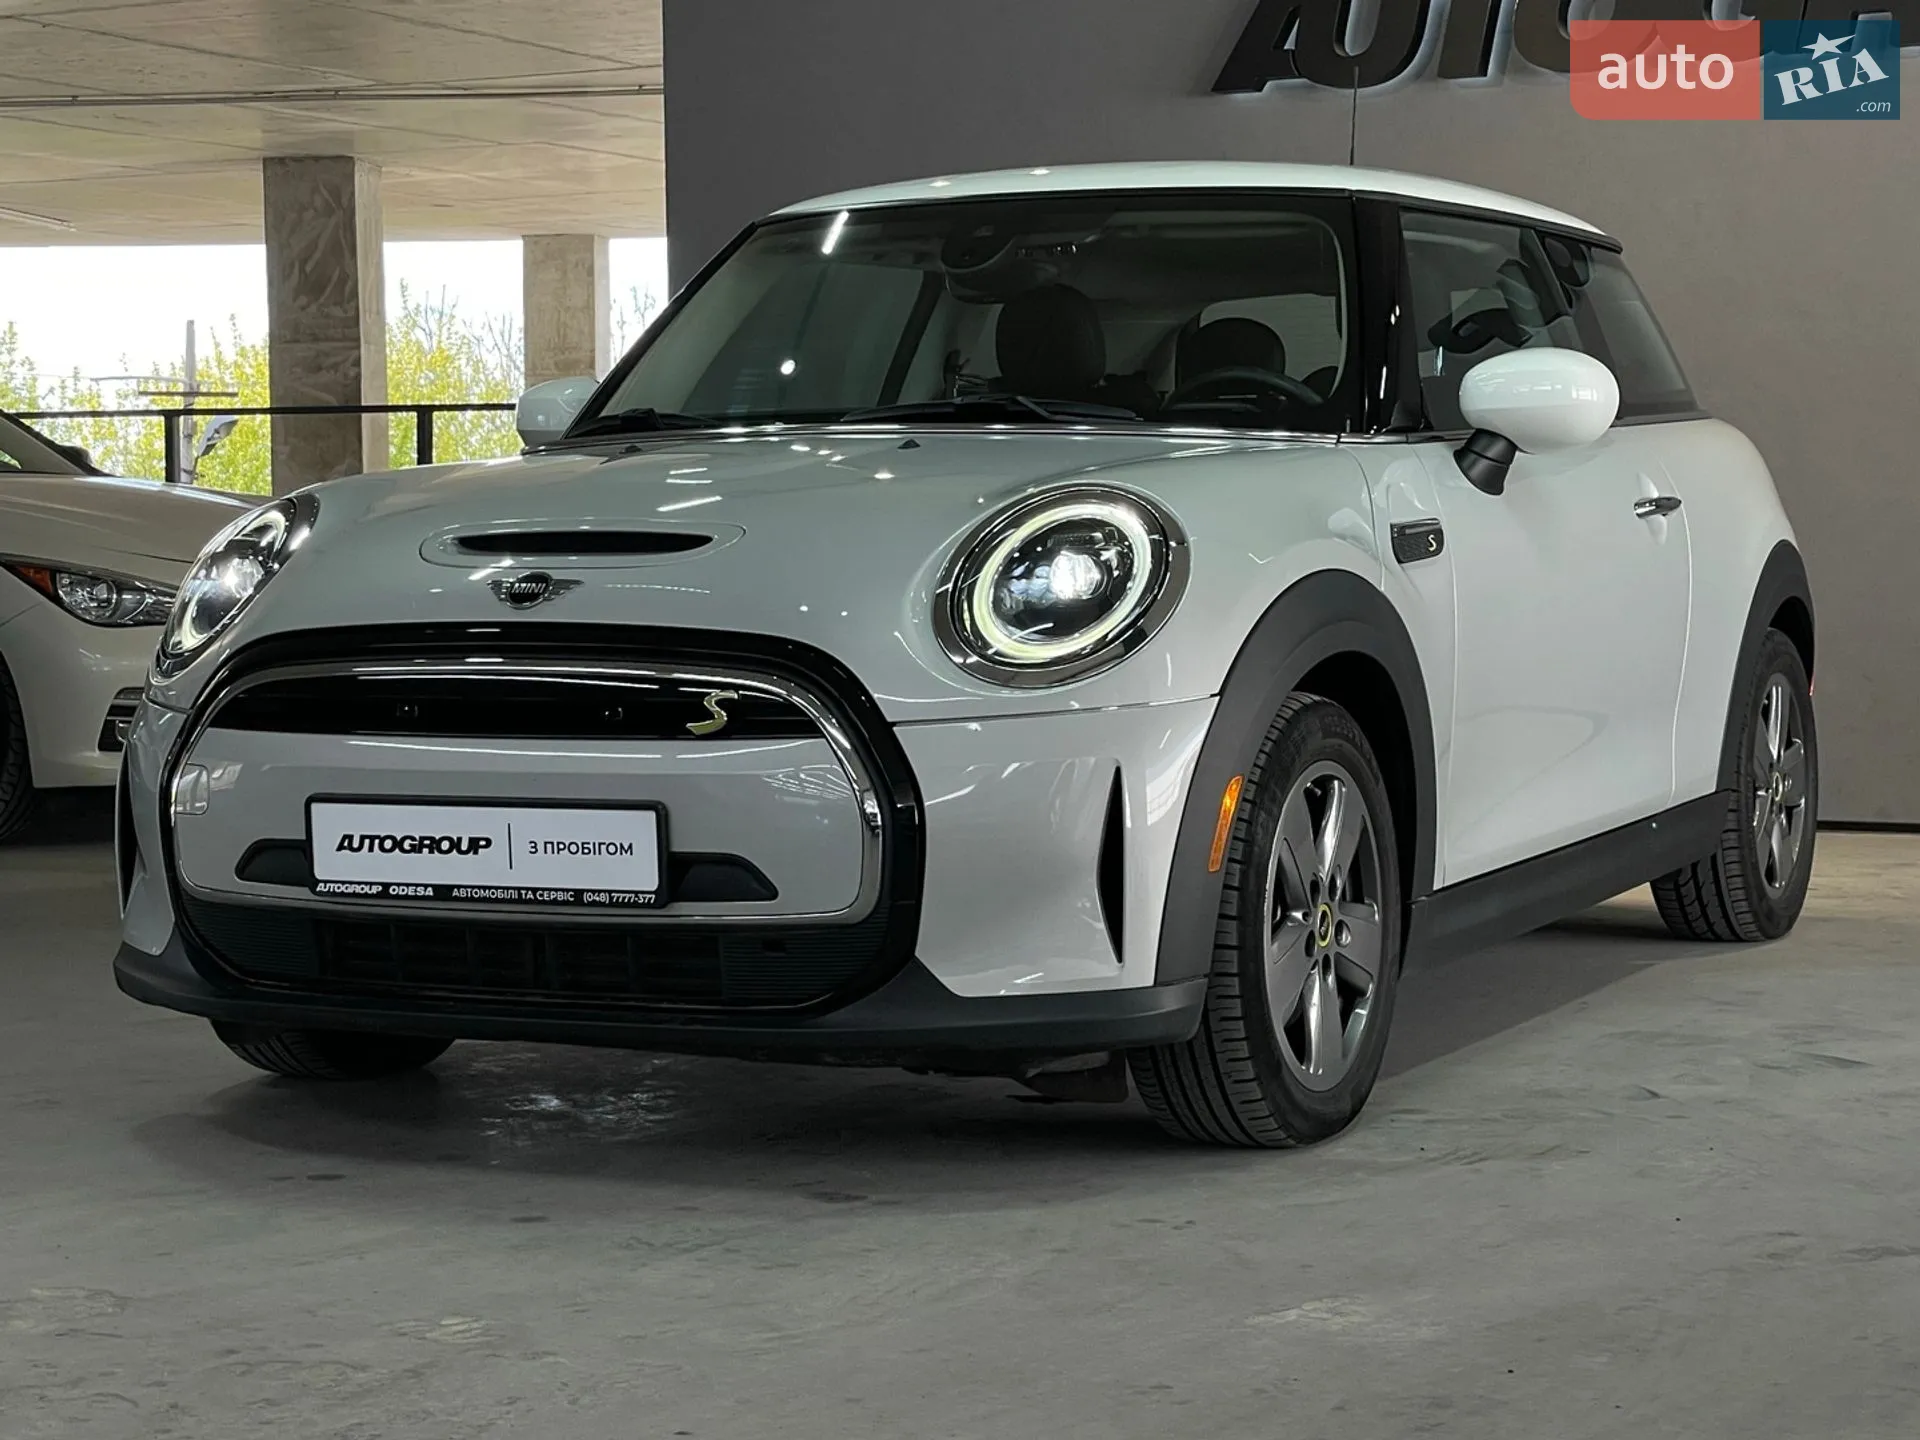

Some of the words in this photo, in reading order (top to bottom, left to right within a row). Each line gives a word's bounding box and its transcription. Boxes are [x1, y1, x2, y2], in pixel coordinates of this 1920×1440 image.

[511, 582, 547, 593] MINI
[685, 689, 739, 736] S
[335, 834, 492, 856] AUTOGROUP
[543, 841, 634, 856] ПРОБІГОМ
[316, 882, 383, 895] AUTOGROUP
[389, 885, 434, 896] ODESA
[452, 887, 518, 900] АВТОМОБІЛІ
[520, 889, 535, 900] ТА
[536, 890, 575, 901] СЕРВІС
[583, 891, 609, 904] (048)
